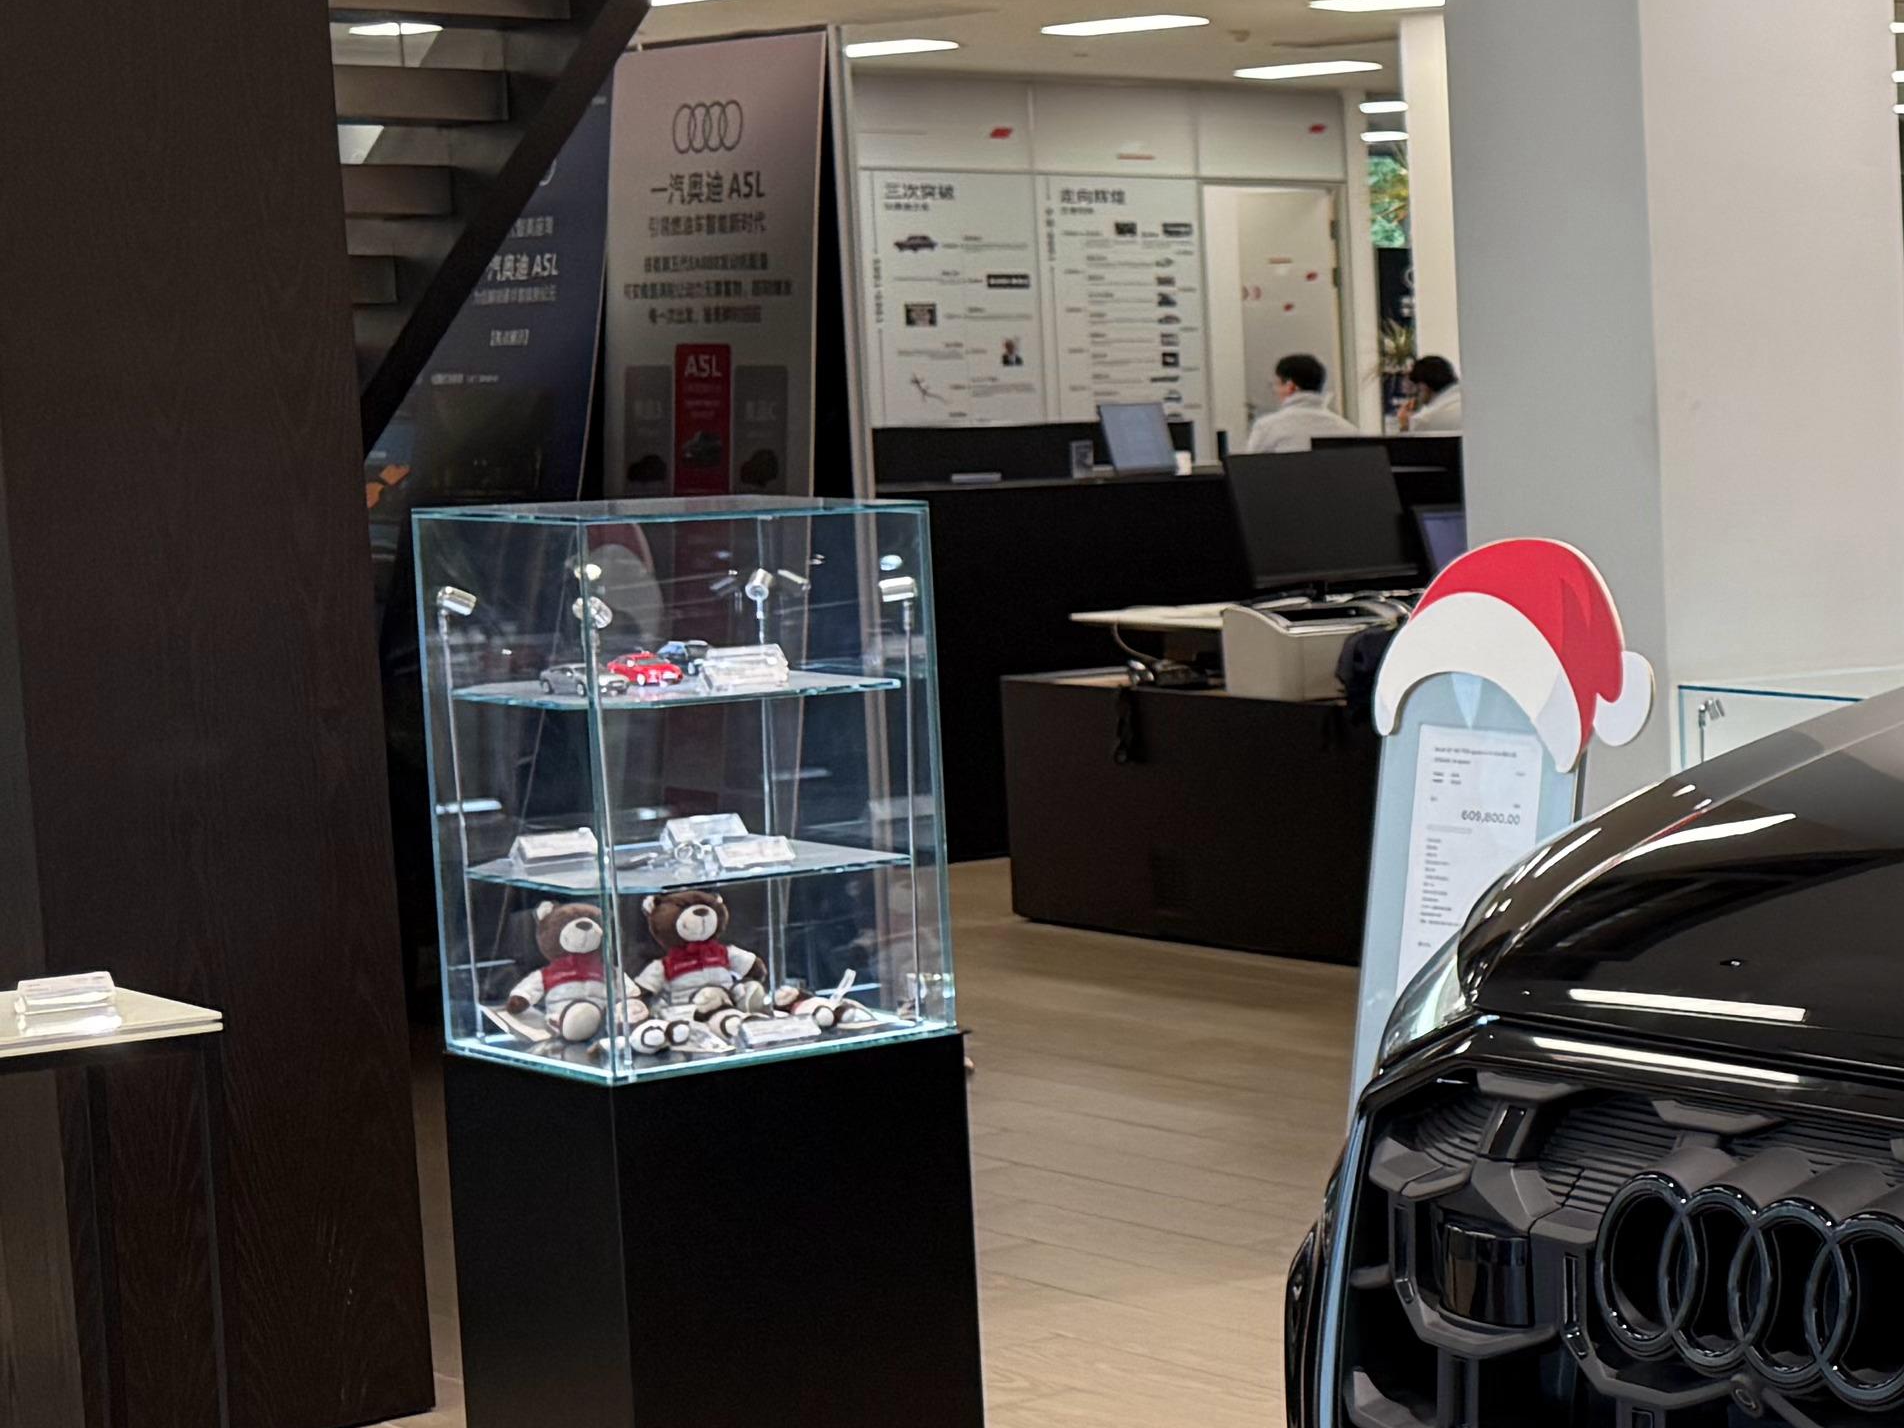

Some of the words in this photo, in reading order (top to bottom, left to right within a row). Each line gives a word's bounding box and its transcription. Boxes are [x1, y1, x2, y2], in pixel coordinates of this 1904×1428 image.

[650, 170, 723, 204] 一汽奥迪
[729, 171, 765, 199] A5L
[1461, 810, 1521, 825] 609,800.00
